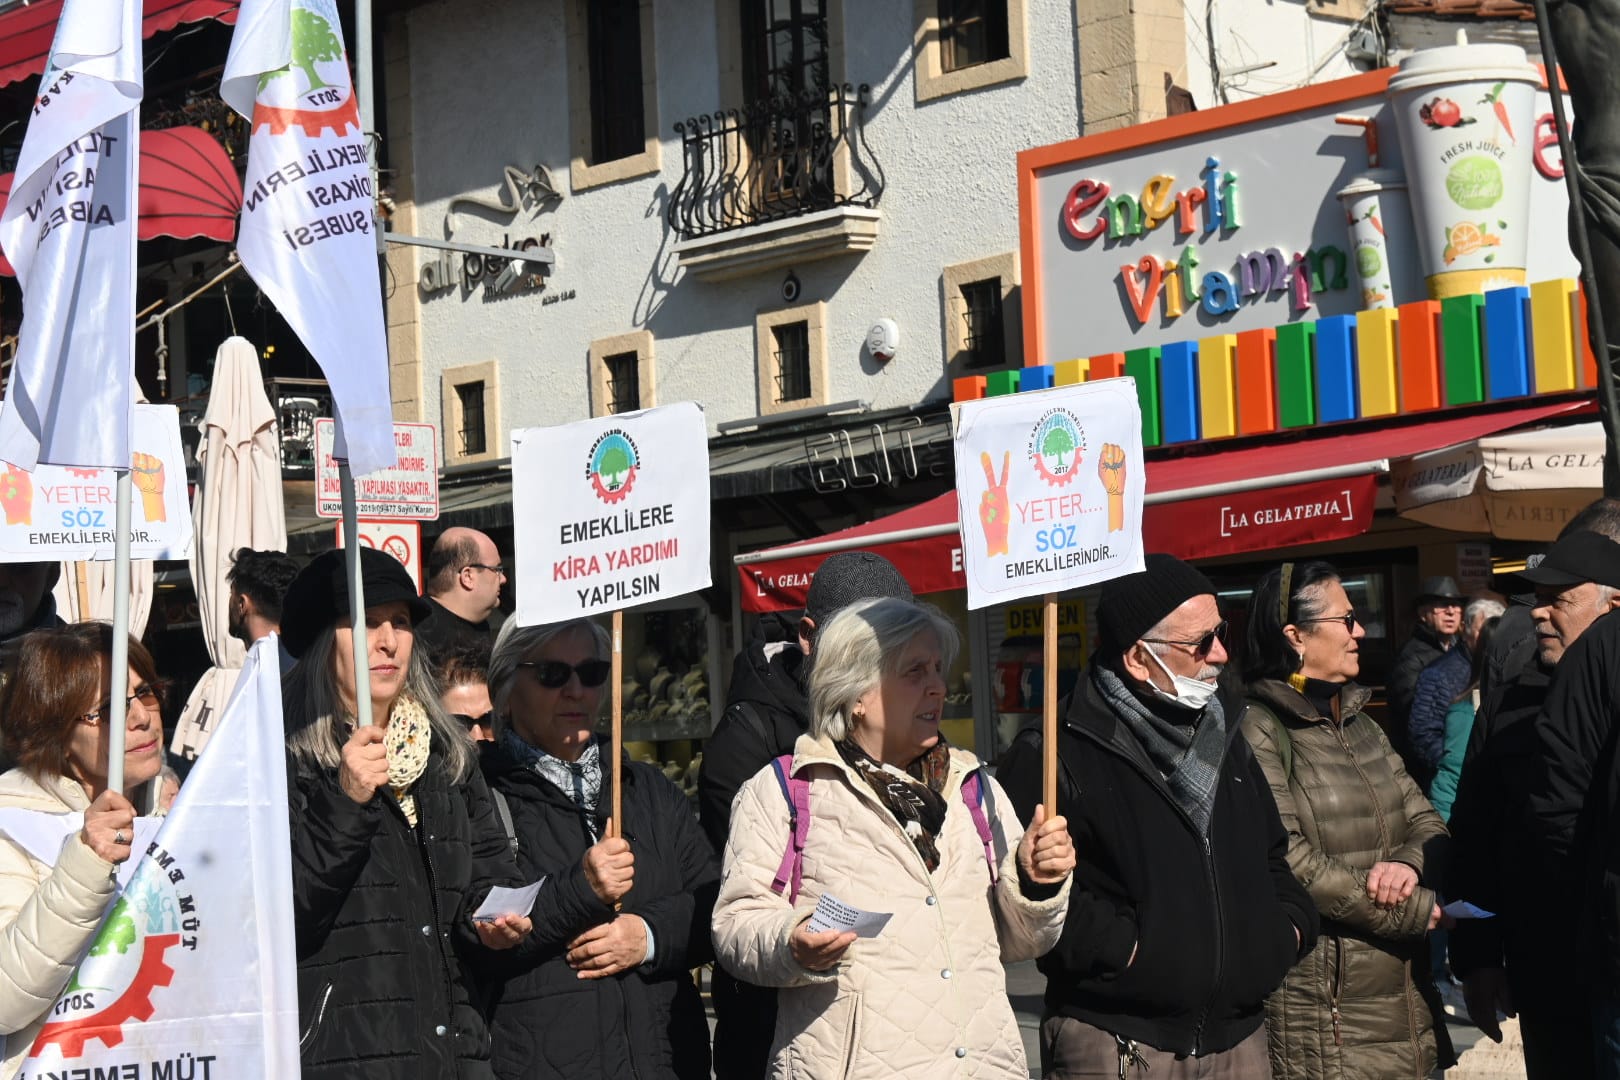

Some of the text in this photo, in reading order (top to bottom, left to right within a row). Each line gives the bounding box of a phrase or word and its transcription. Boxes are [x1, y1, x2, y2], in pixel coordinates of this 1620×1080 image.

[1440, 141, 1505, 164] FRESH JUICE
[1063, 156, 1242, 240] enerji
[1508, 453, 1606, 471] LA GELA
[61, 507, 106, 527] SÖZ
[560, 504, 674, 545] EMEKLİLERE
[1230, 500, 1341, 528] LA GELATERIA
[1036, 523, 1077, 552] SÖZ
[553, 538, 678, 582] KİRA YARDIMI
[577, 573, 660, 608] YAPILSIN
[1010, 605, 1079, 630] DEVEN
